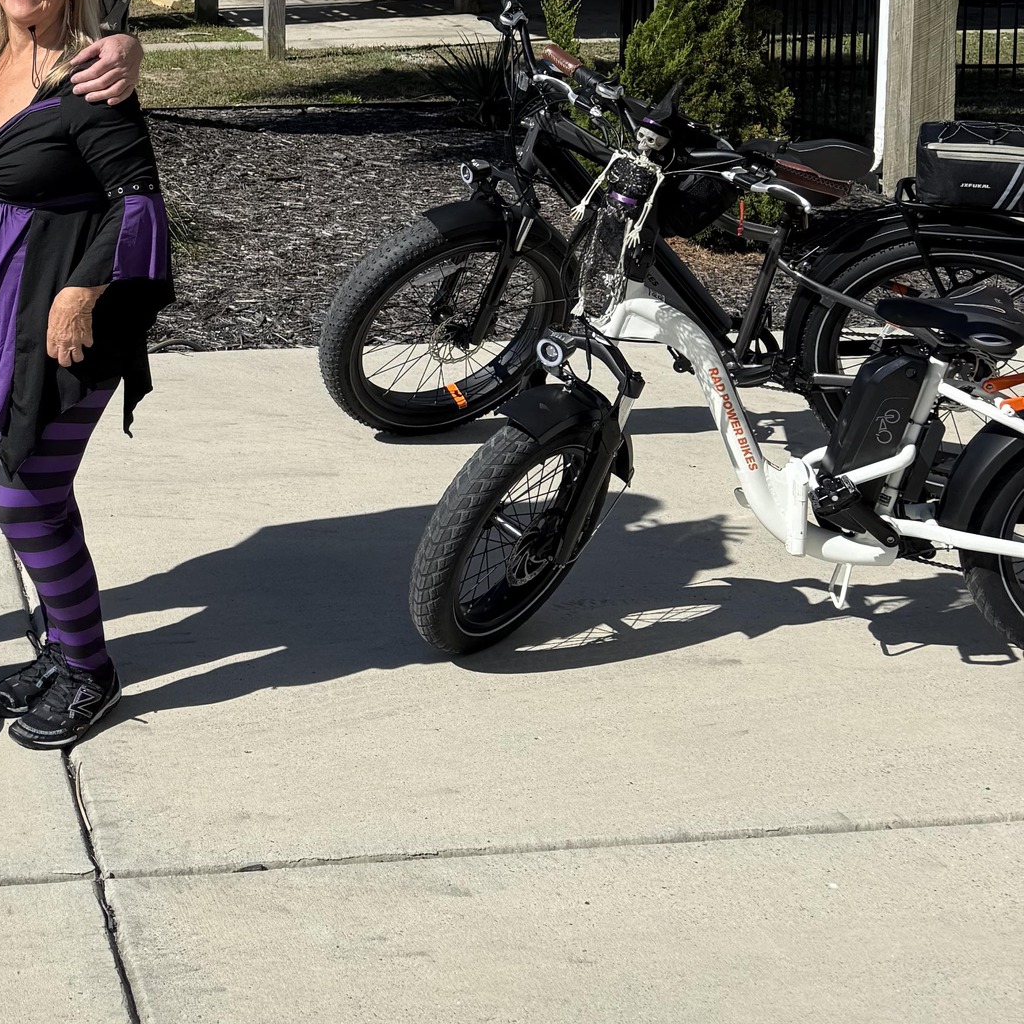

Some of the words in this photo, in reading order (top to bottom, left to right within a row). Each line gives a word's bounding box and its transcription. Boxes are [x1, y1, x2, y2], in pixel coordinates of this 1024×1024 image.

[708, 367, 726, 393] RAD
[719, 393, 744, 436] POWER
[737, 437, 759, 472] BIKES
